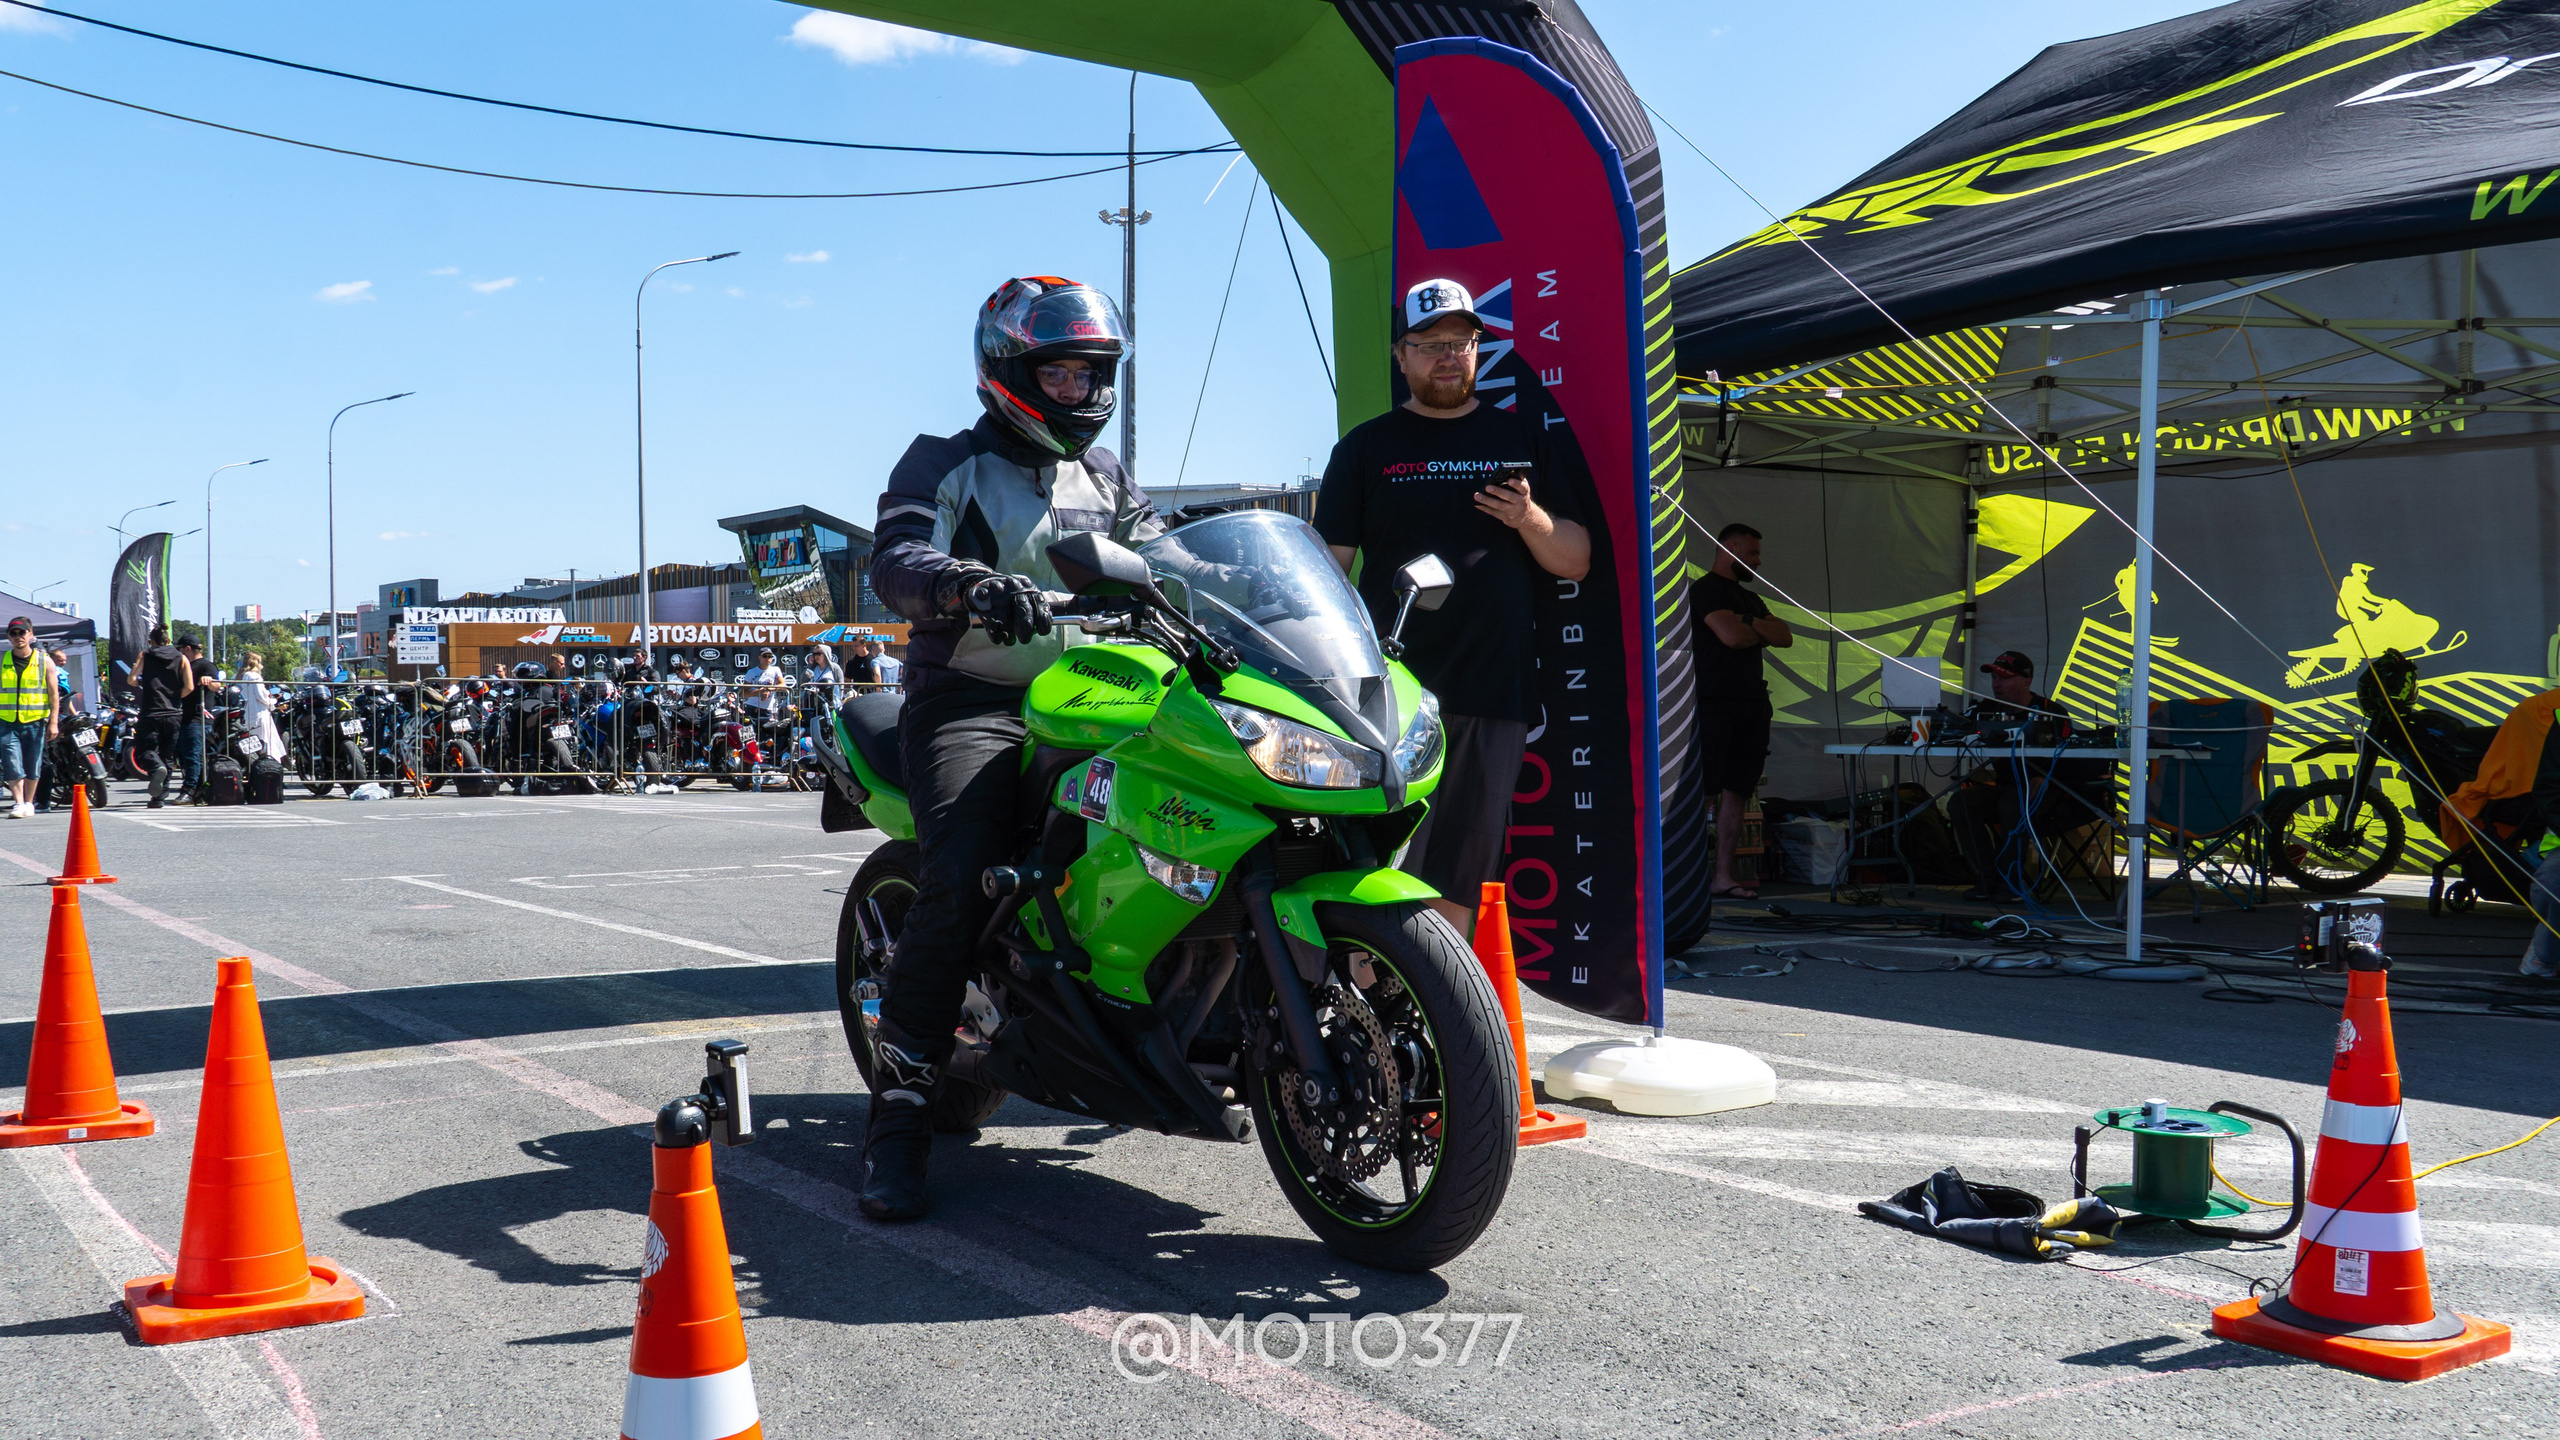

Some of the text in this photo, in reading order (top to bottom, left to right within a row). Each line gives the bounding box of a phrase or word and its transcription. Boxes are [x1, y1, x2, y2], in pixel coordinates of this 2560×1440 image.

[1537, 269, 1566, 431] TEAM
[1382, 461, 1499, 475] MOTOGYMKHA
[1392, 474, 1474, 482] EKATERINBURG
[1076, 514, 1105, 525] MCP
[562, 626, 595, 634] АВТО
[629, 625, 793, 644] АВТОЗАПЧАСТИ
[845, 626, 874, 634] АВТО
[560, 634, 611, 643] ЯПОНЕЦ
[1067, 659, 1144, 692] Kawasaki
[1555, 579, 1595, 985] EKATERINBU
[1089, 776, 1111, 805] 48
[1157, 796, 1216, 831] Ninja
